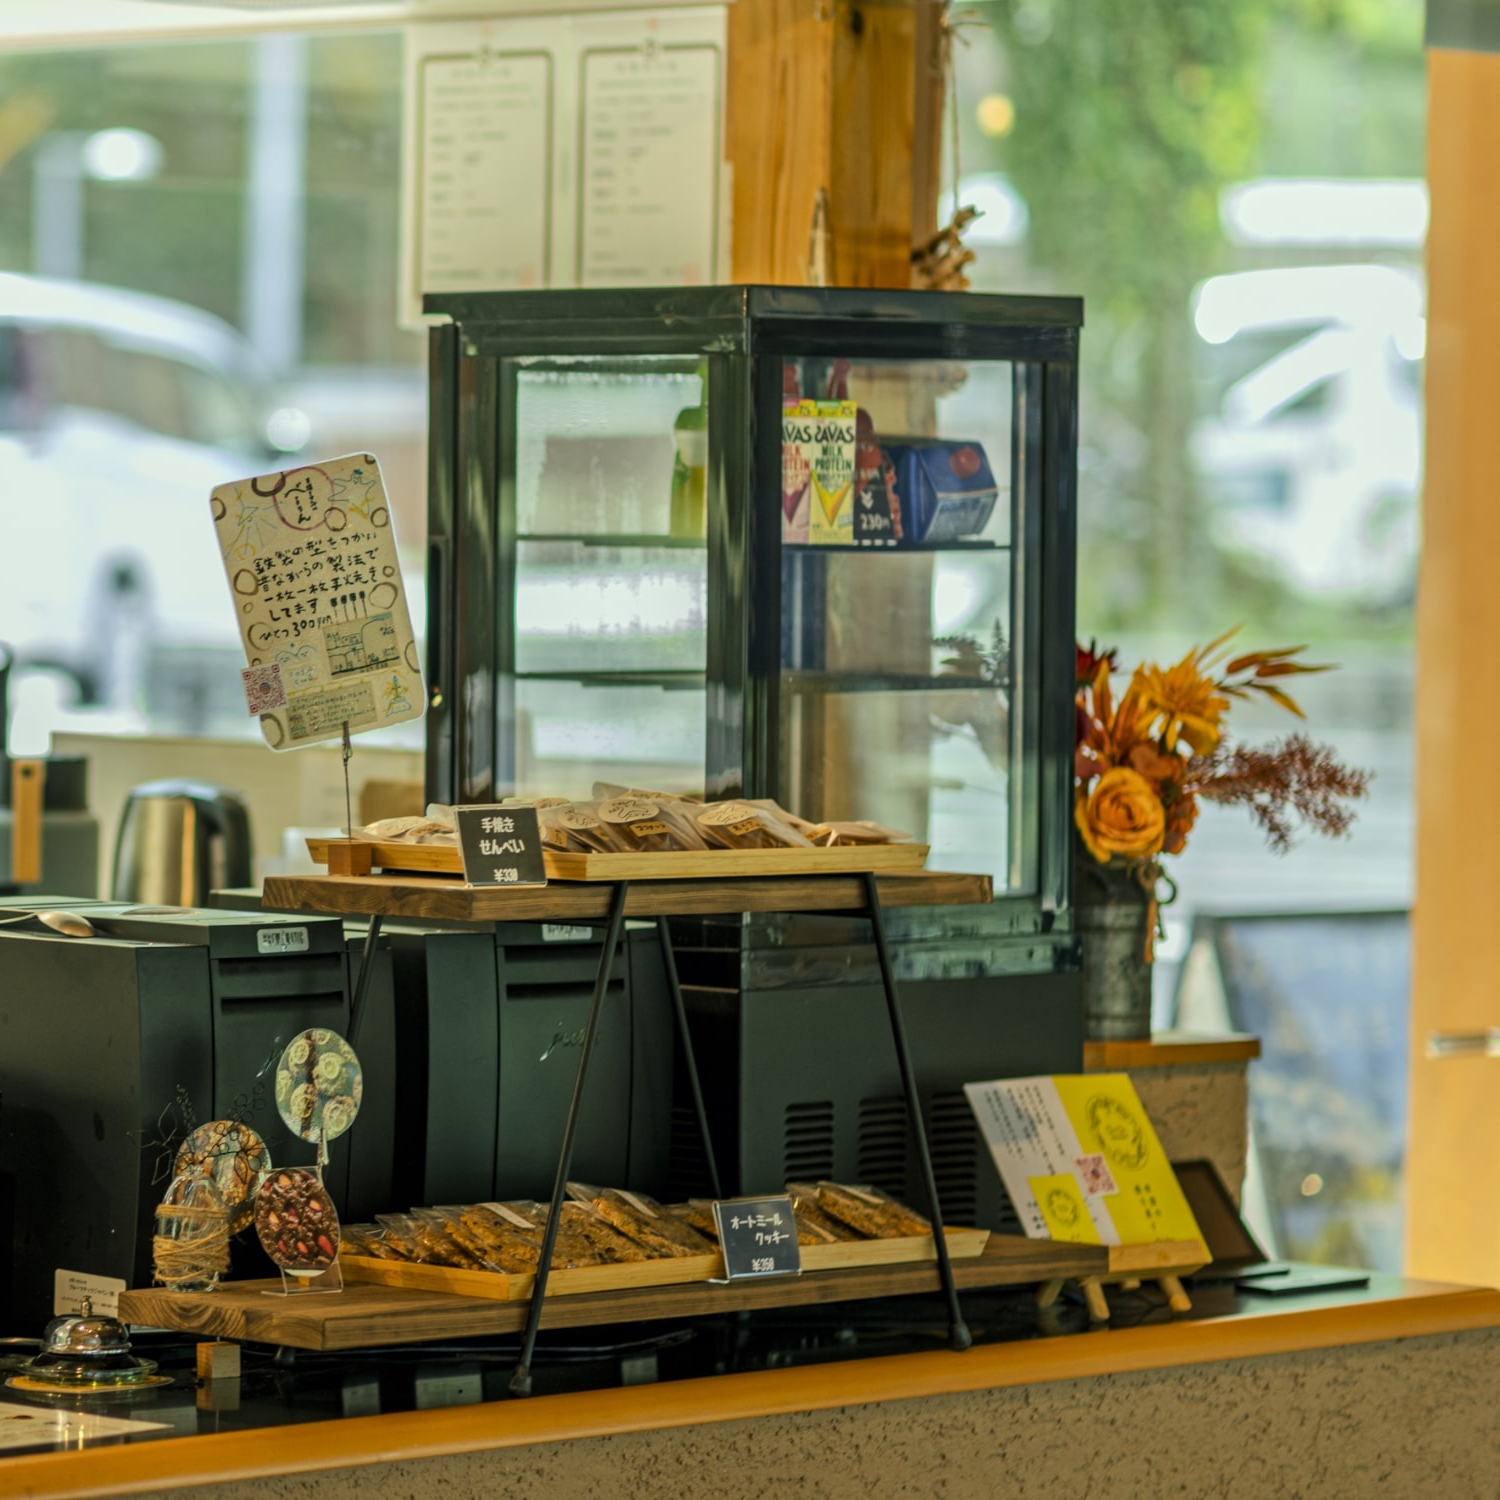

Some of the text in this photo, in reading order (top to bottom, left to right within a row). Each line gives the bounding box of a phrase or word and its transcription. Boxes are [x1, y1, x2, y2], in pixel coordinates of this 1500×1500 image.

[814, 423, 854, 444] SAVAS
[821, 445, 843, 457] MILK
[815, 459, 852, 472] PROTEIN
[263, 566, 378, 603] 一枚一枚手焼き
[268, 598, 319, 622] してます
[480, 816, 516, 834] 手焼き
[478, 838, 526, 856] せんべい
[730, 1212, 783, 1231] オートミール
[755, 1230, 791, 1247] クッキー
